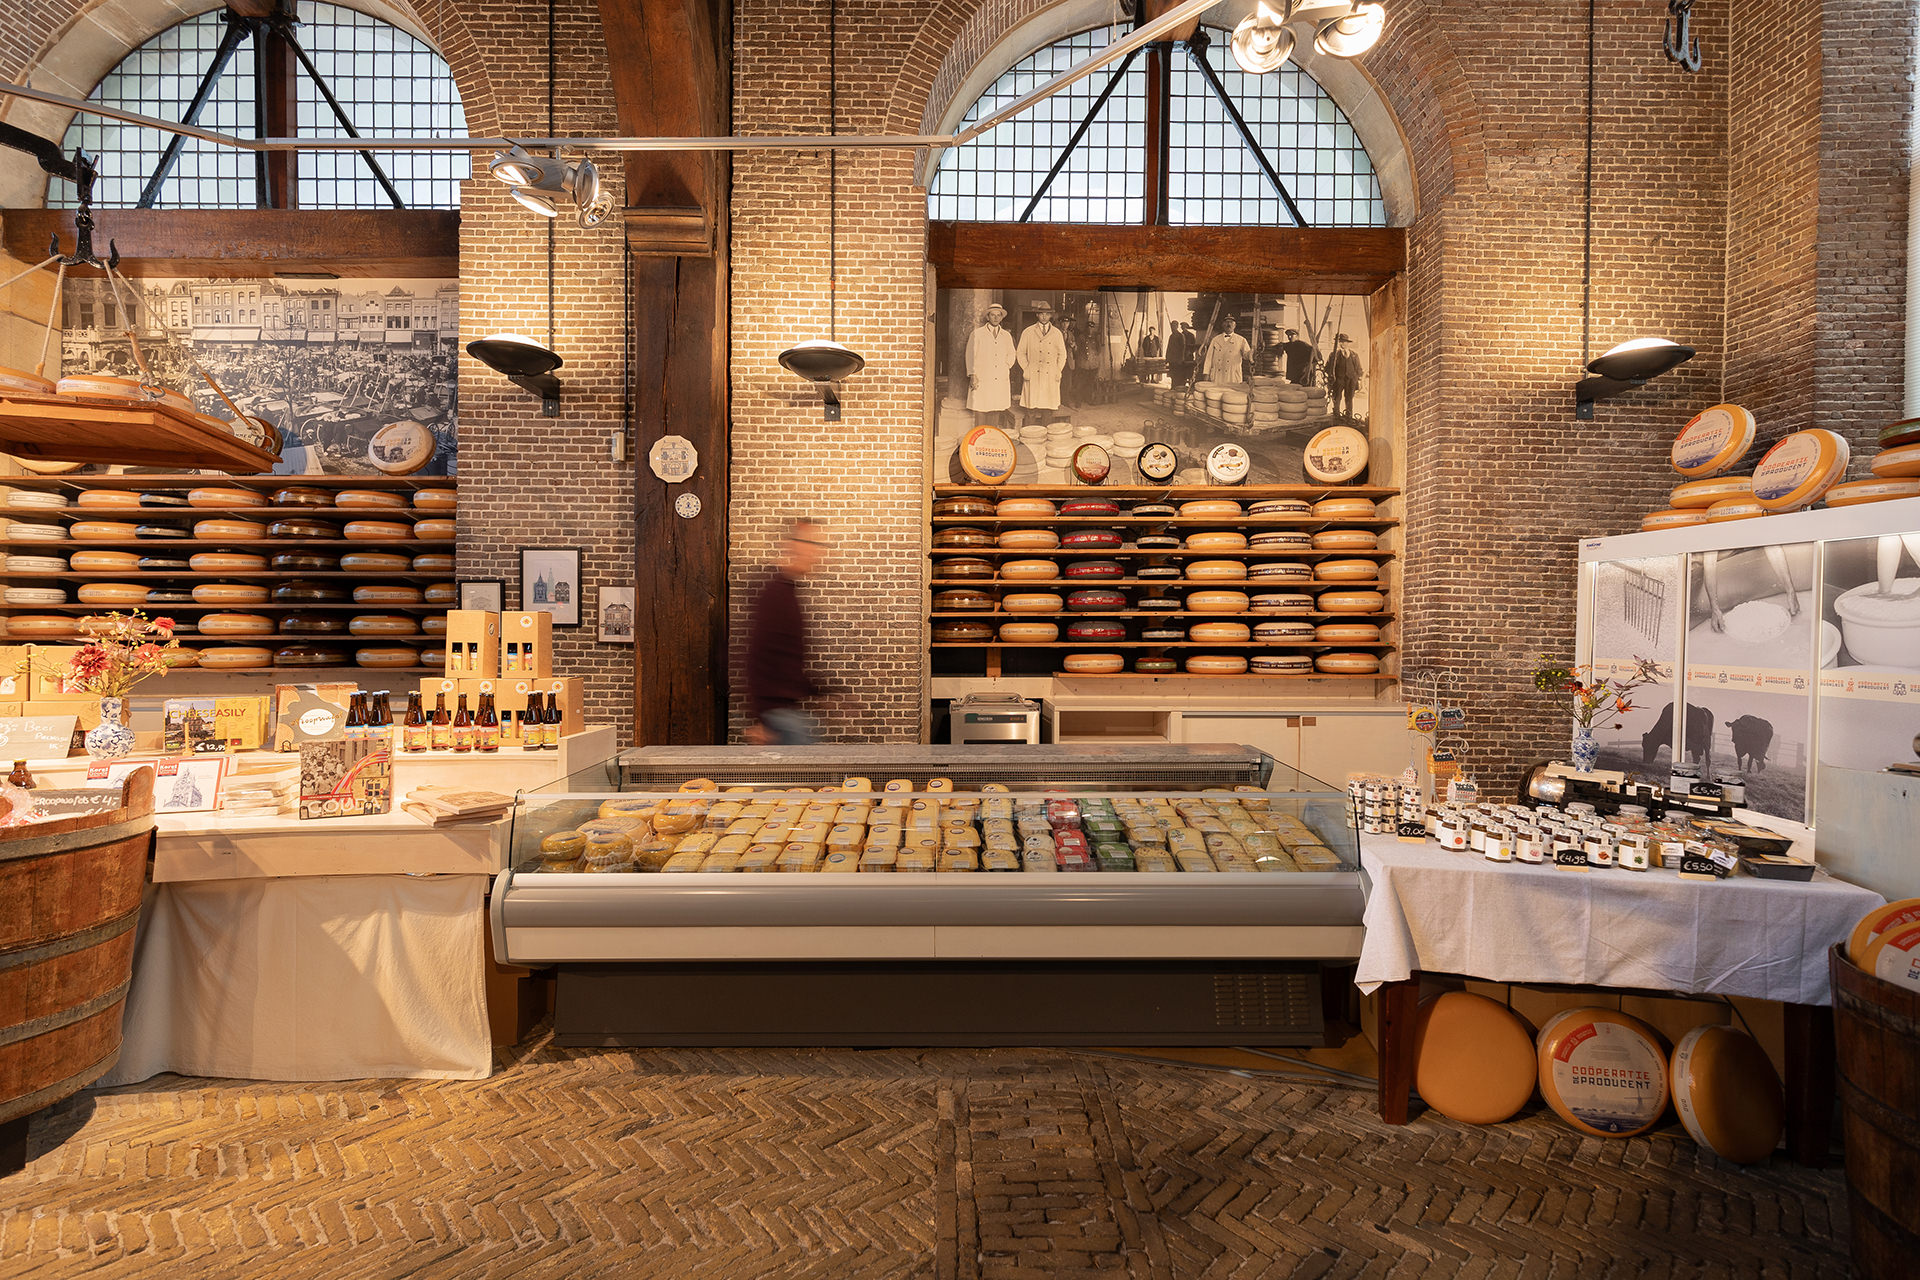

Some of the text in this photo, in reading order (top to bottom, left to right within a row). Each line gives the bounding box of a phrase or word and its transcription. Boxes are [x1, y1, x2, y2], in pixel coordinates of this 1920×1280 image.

[169, 708, 247, 719] CHEESEASILY
[1683, 860, 1714, 872] €5,50
[1572, 1065, 1651, 1081] COÖPERATIE
[1580, 1076, 1651, 1090] PRODUCENT
